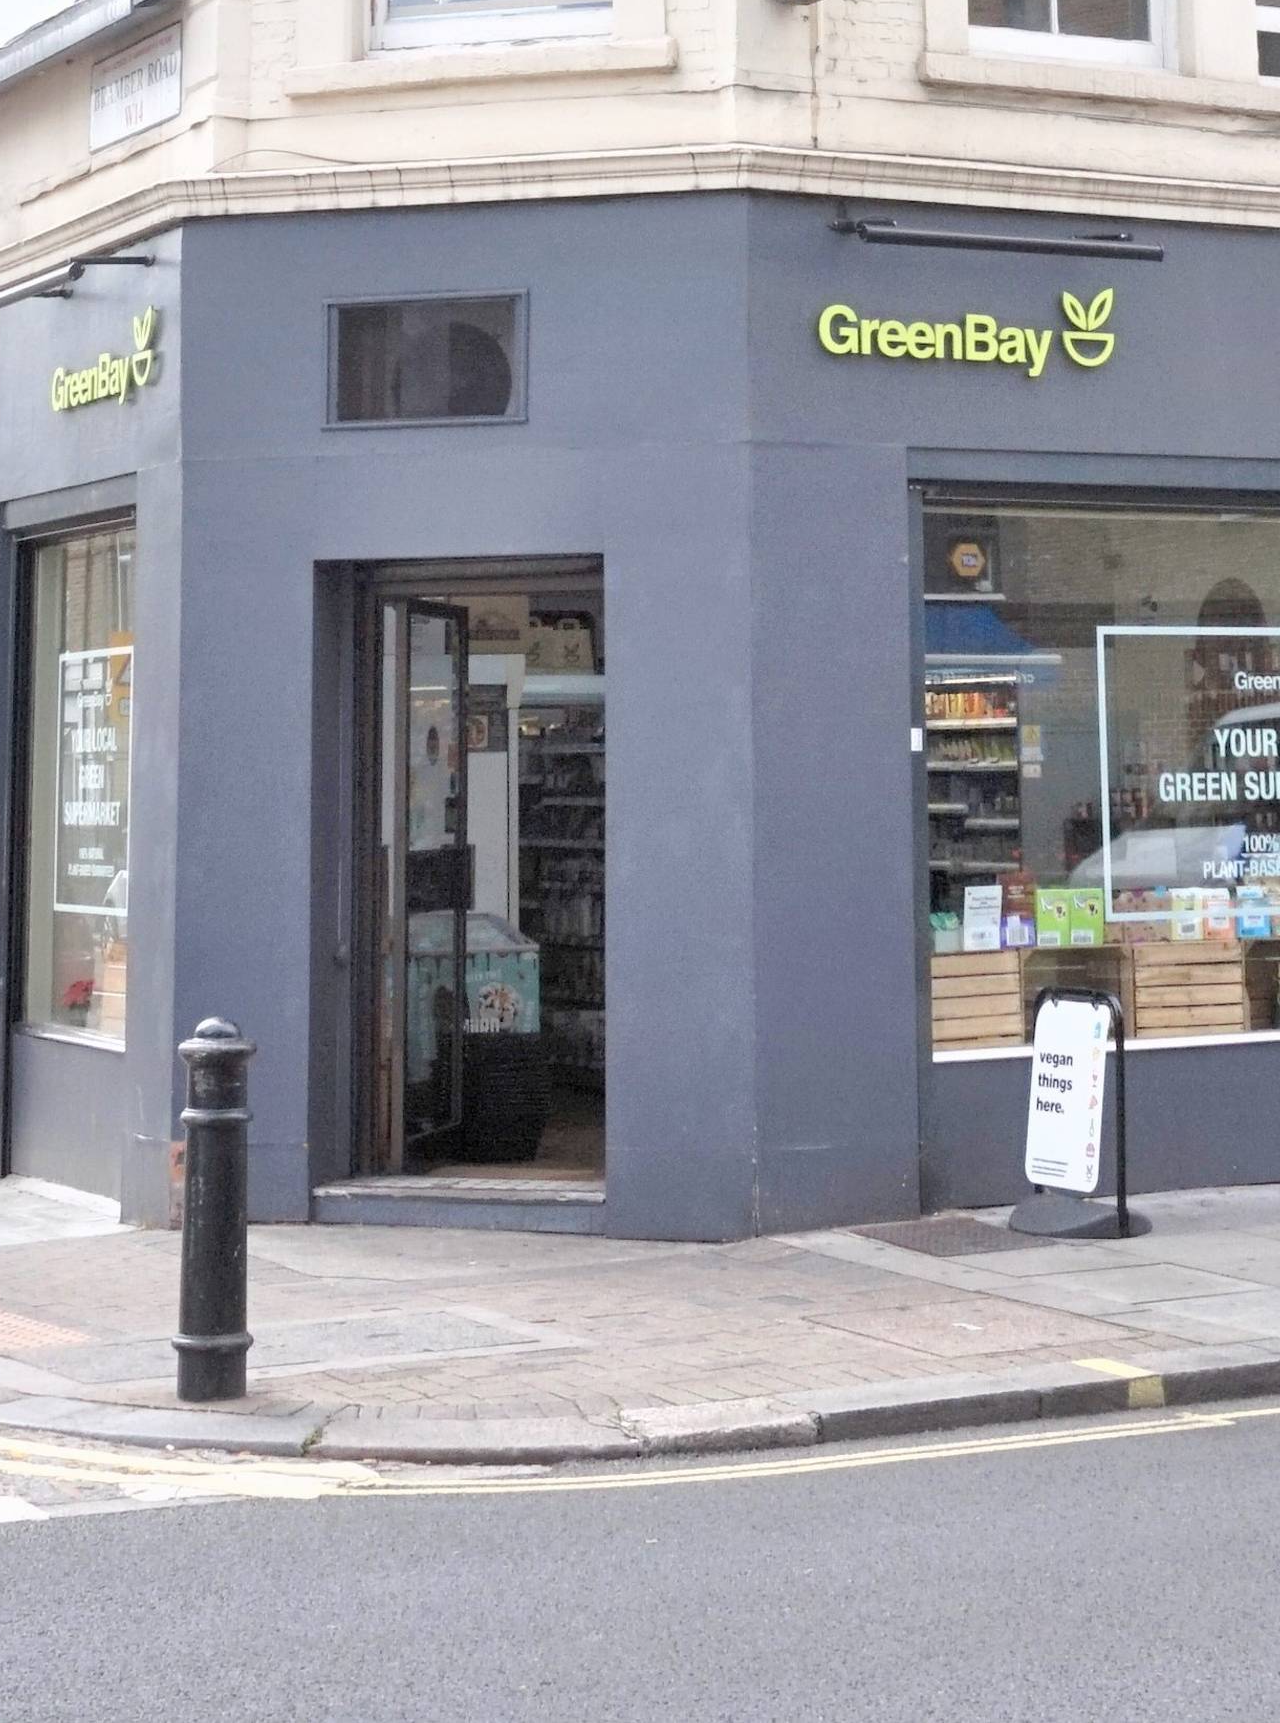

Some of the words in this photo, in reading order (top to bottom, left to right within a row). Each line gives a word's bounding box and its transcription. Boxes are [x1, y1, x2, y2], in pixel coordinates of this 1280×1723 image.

[147, 52, 178, 87] ROAD
[818, 304, 1053, 377] GreenBay
[52, 353, 129, 412] GreenBay
[92, 726, 118, 752] LOCAL
[1214, 728, 1278, 757] YOUR
[79, 764, 105, 789] GREEN
[1159, 772, 1237, 802] GREEN
[63, 801, 121, 826] SUPERMARKET
[1243, 834, 1280, 853] 100%
[1039, 1051, 1074, 1068] vegan
[1038, 1074, 1073, 1093] things
[1036, 1097, 1065, 1114] here.
